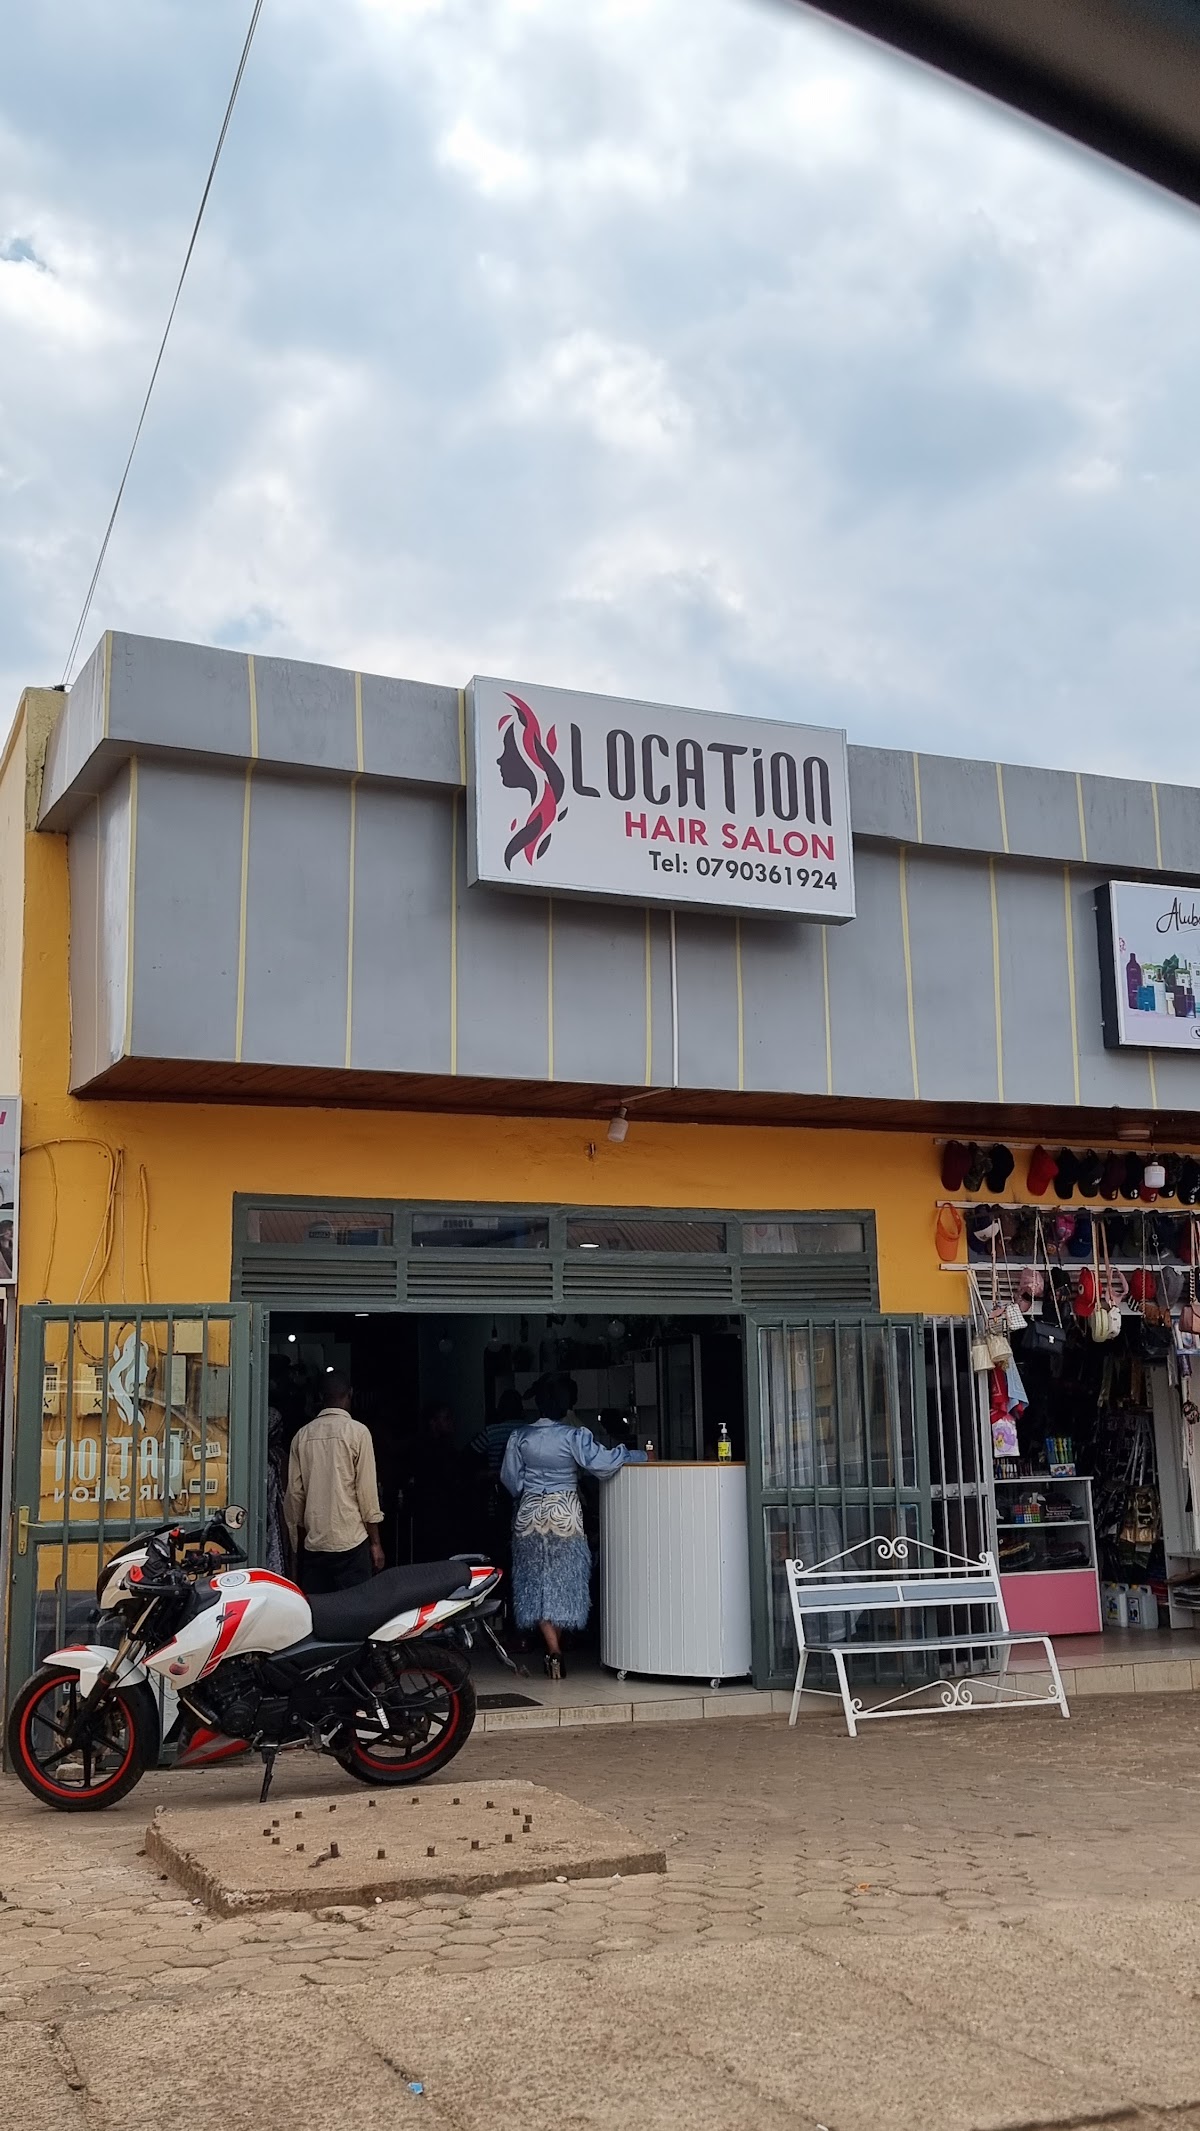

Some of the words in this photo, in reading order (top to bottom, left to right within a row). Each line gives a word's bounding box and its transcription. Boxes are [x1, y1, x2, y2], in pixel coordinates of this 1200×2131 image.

[625, 811, 709, 846] HAIR
[722, 823, 835, 860] SALON
[649, 850, 688, 875] Tel:
[696, 856, 838, 890] 0790361924
[1156, 897, 1200, 933] Alub
